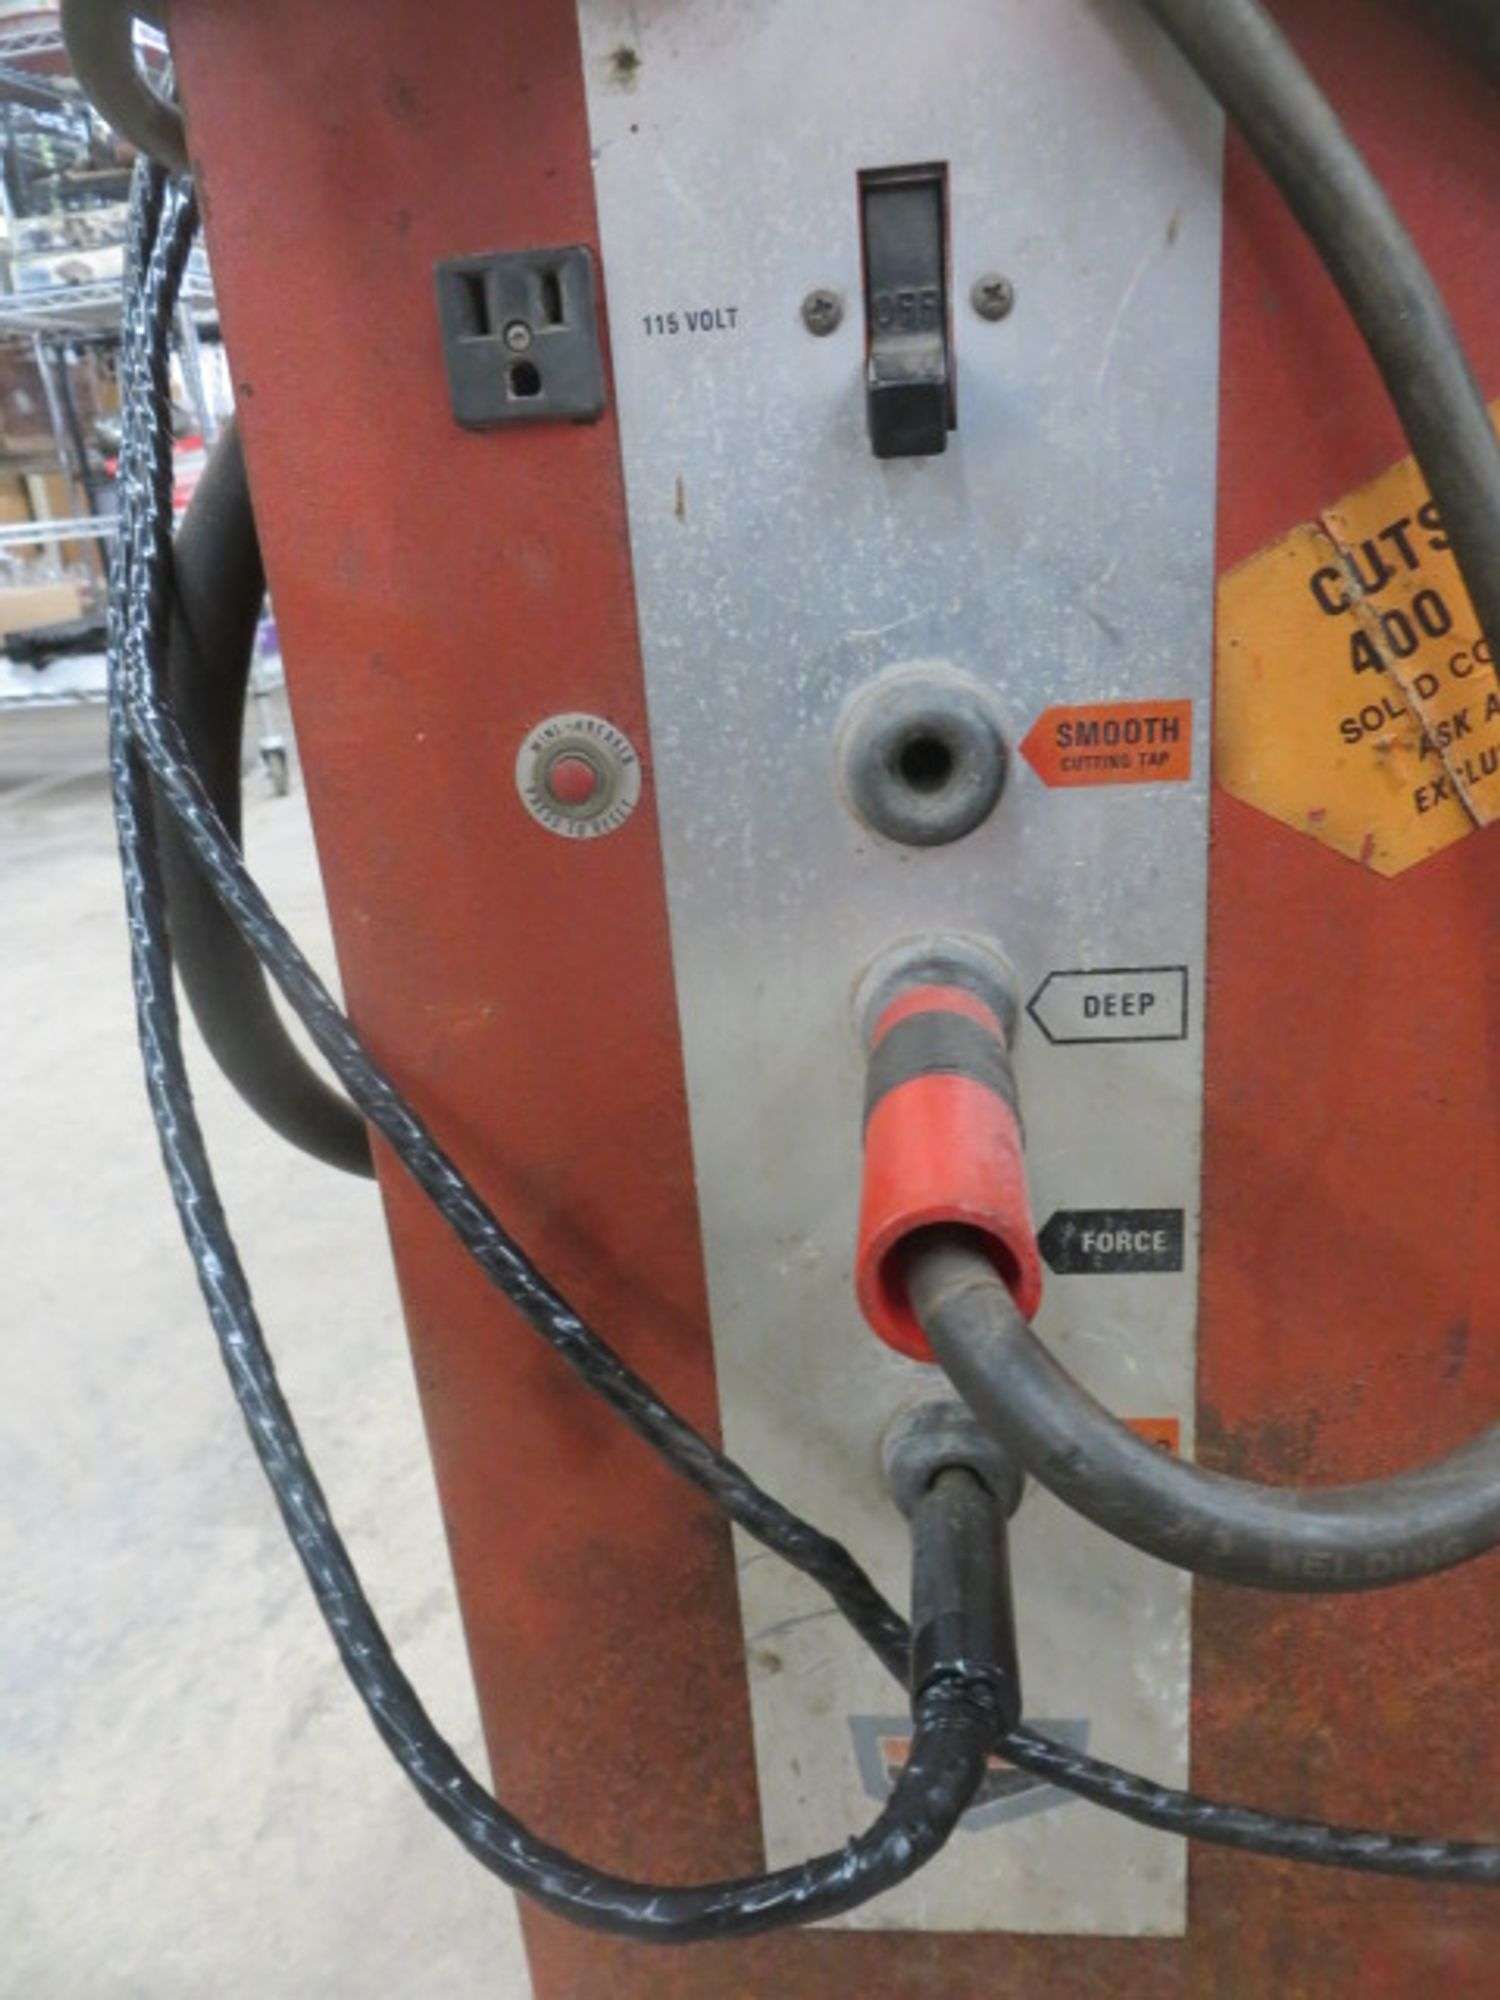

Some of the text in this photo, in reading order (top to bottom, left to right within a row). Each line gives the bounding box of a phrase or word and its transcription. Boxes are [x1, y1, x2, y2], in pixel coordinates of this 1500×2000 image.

[642, 305, 739, 336] 115 VOLT
[1351, 589, 1453, 675] 400
[1340, 673, 1440, 743] SOLD
[1056, 715, 1181, 749] SMOOTH
[1060, 751, 1171, 772] CUTTING TAP
[1414, 746, 1499, 815] EXLU
[1083, 992, 1156, 1018] DEEP
[1081, 1229, 1169, 1253] FORCE
